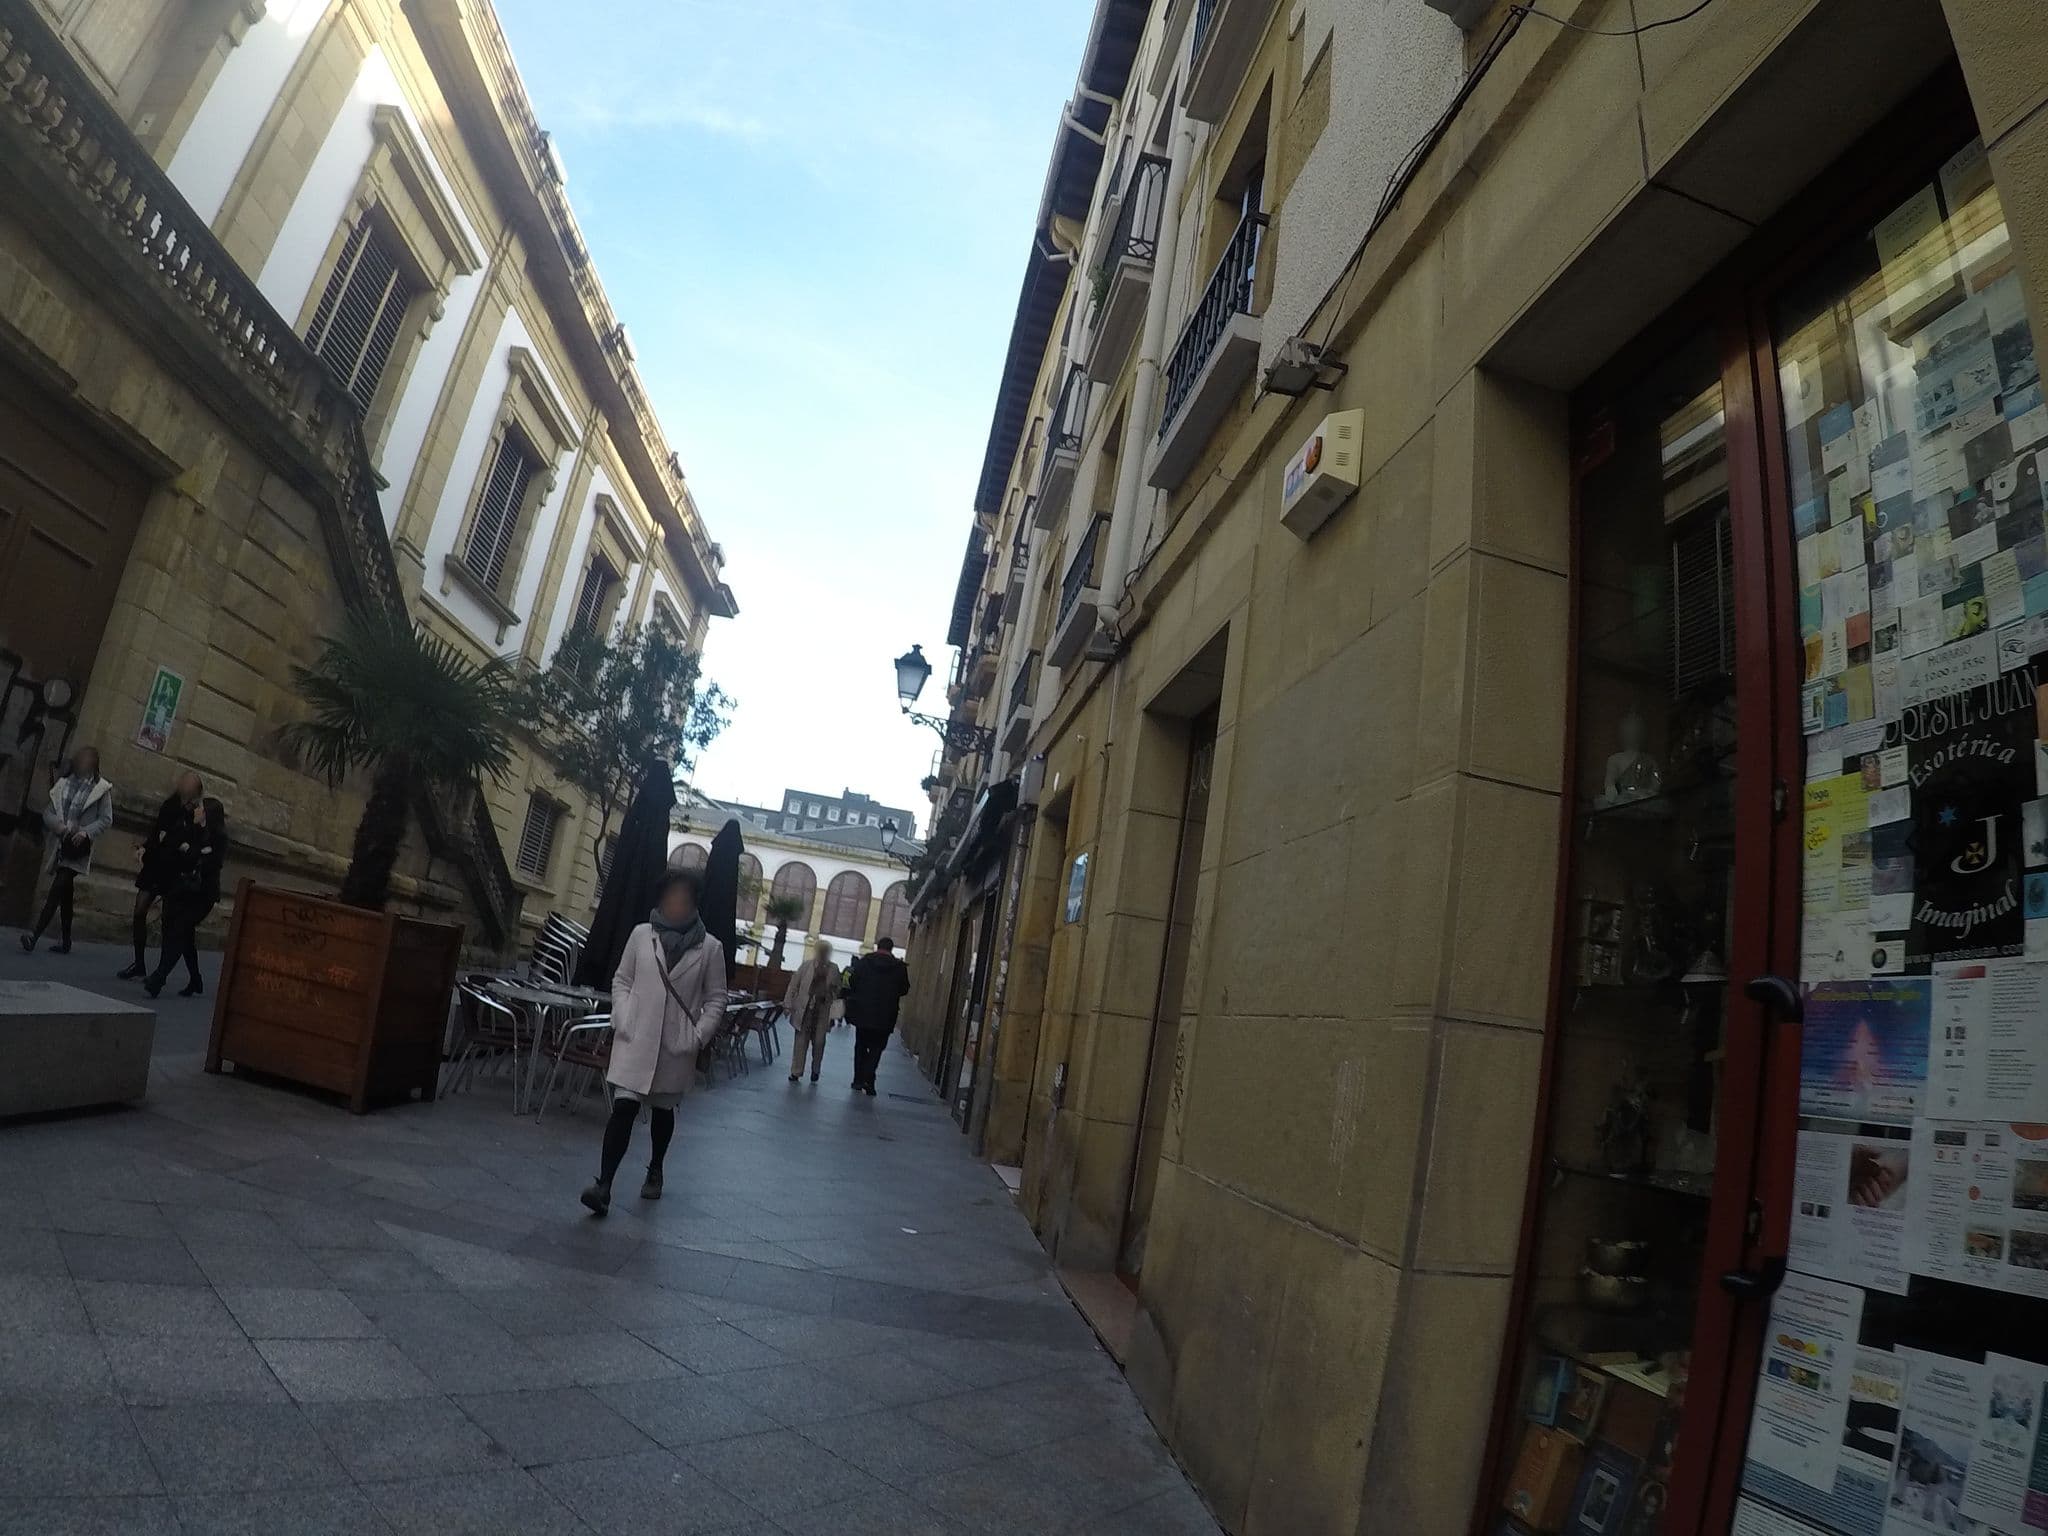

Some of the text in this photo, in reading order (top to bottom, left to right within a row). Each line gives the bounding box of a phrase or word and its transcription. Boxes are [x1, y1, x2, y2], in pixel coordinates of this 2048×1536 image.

[1979, 665, 2039, 721] JUAN
[1908, 733, 2016, 789] Esotérica
[1914, 878, 2018, 939] Imaginal
